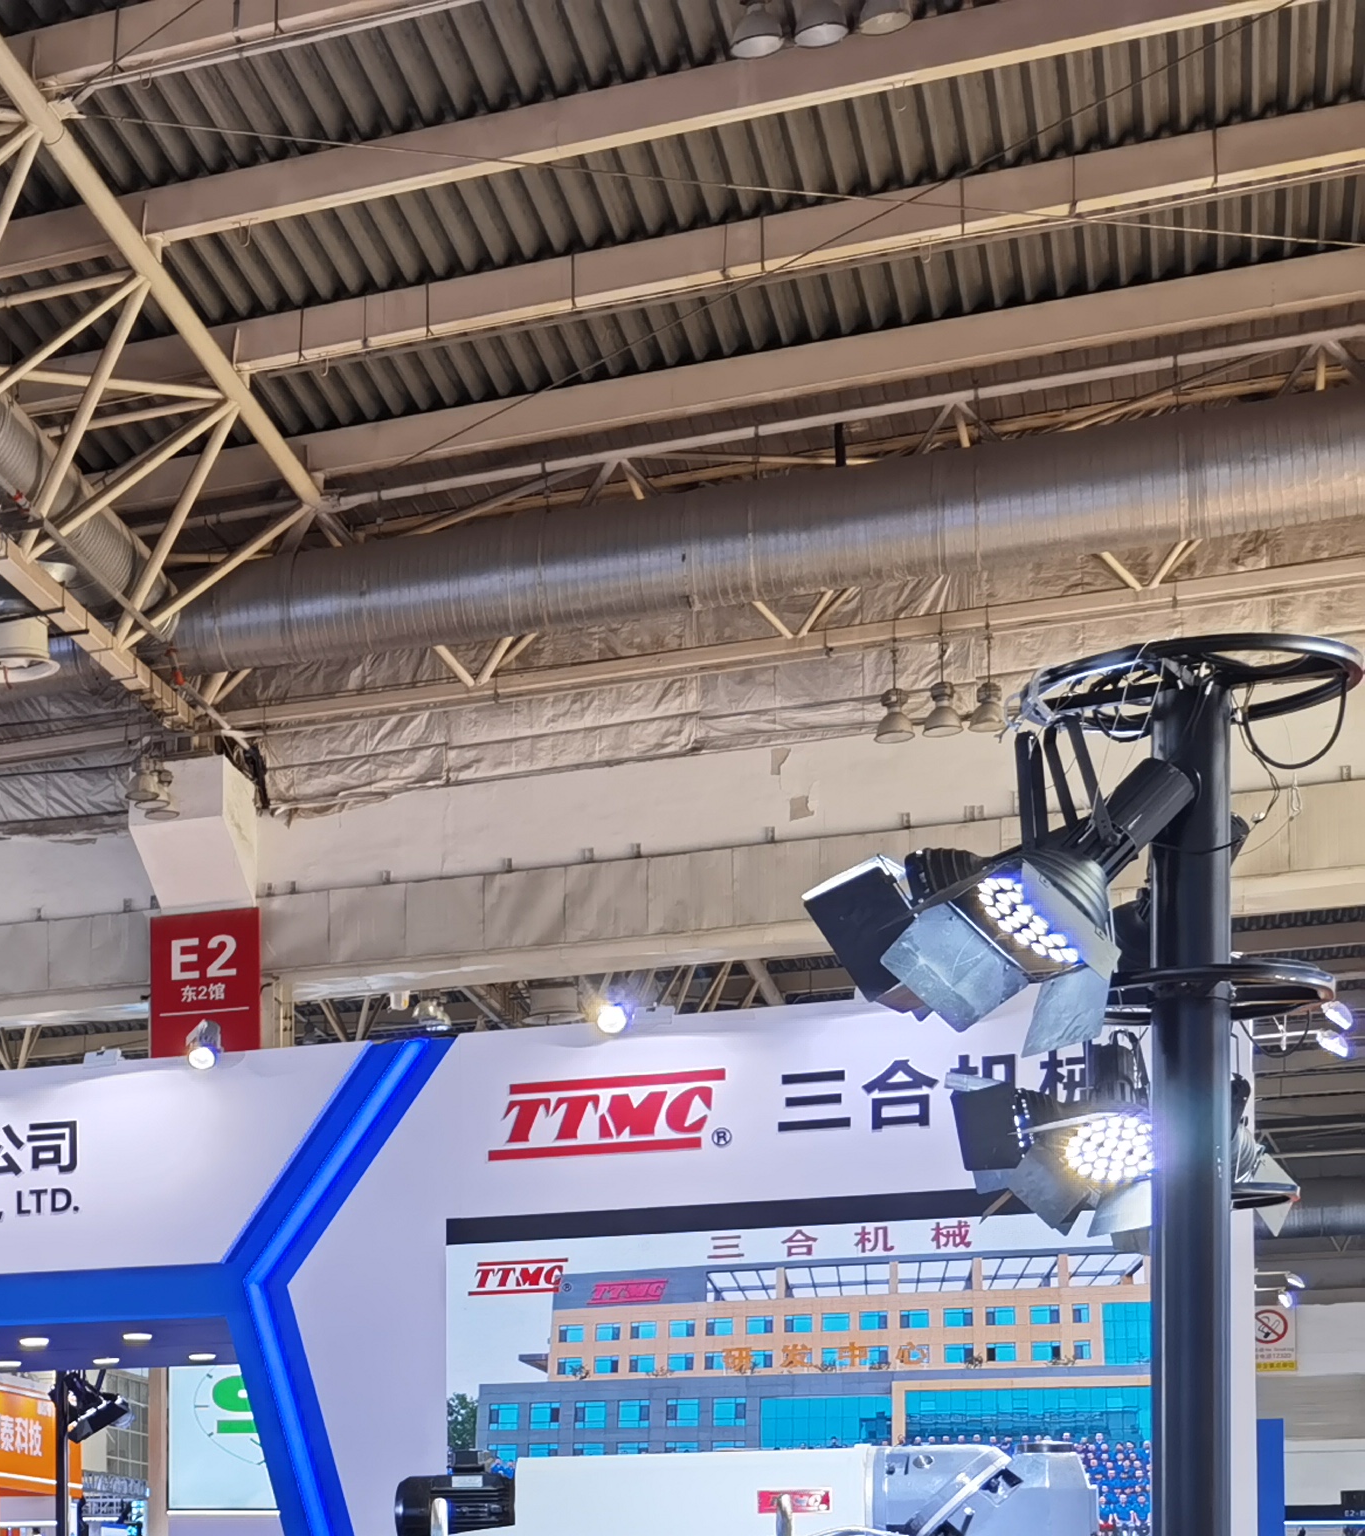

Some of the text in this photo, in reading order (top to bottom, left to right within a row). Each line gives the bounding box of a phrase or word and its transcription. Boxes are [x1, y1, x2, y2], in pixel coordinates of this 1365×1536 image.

[170, 933, 237, 981] E2
[180, 983, 226, 1003] 东2馆
[499, 1082, 715, 1146] TTMC
[14, 1187, 80, 1216] LTD.
[707, 1220, 973, 1259] 三合机械
[473, 1262, 565, 1291] TTMC
[589, 1280, 667, 1302] TTMC
[723, 1341, 927, 1370] 研发中心
